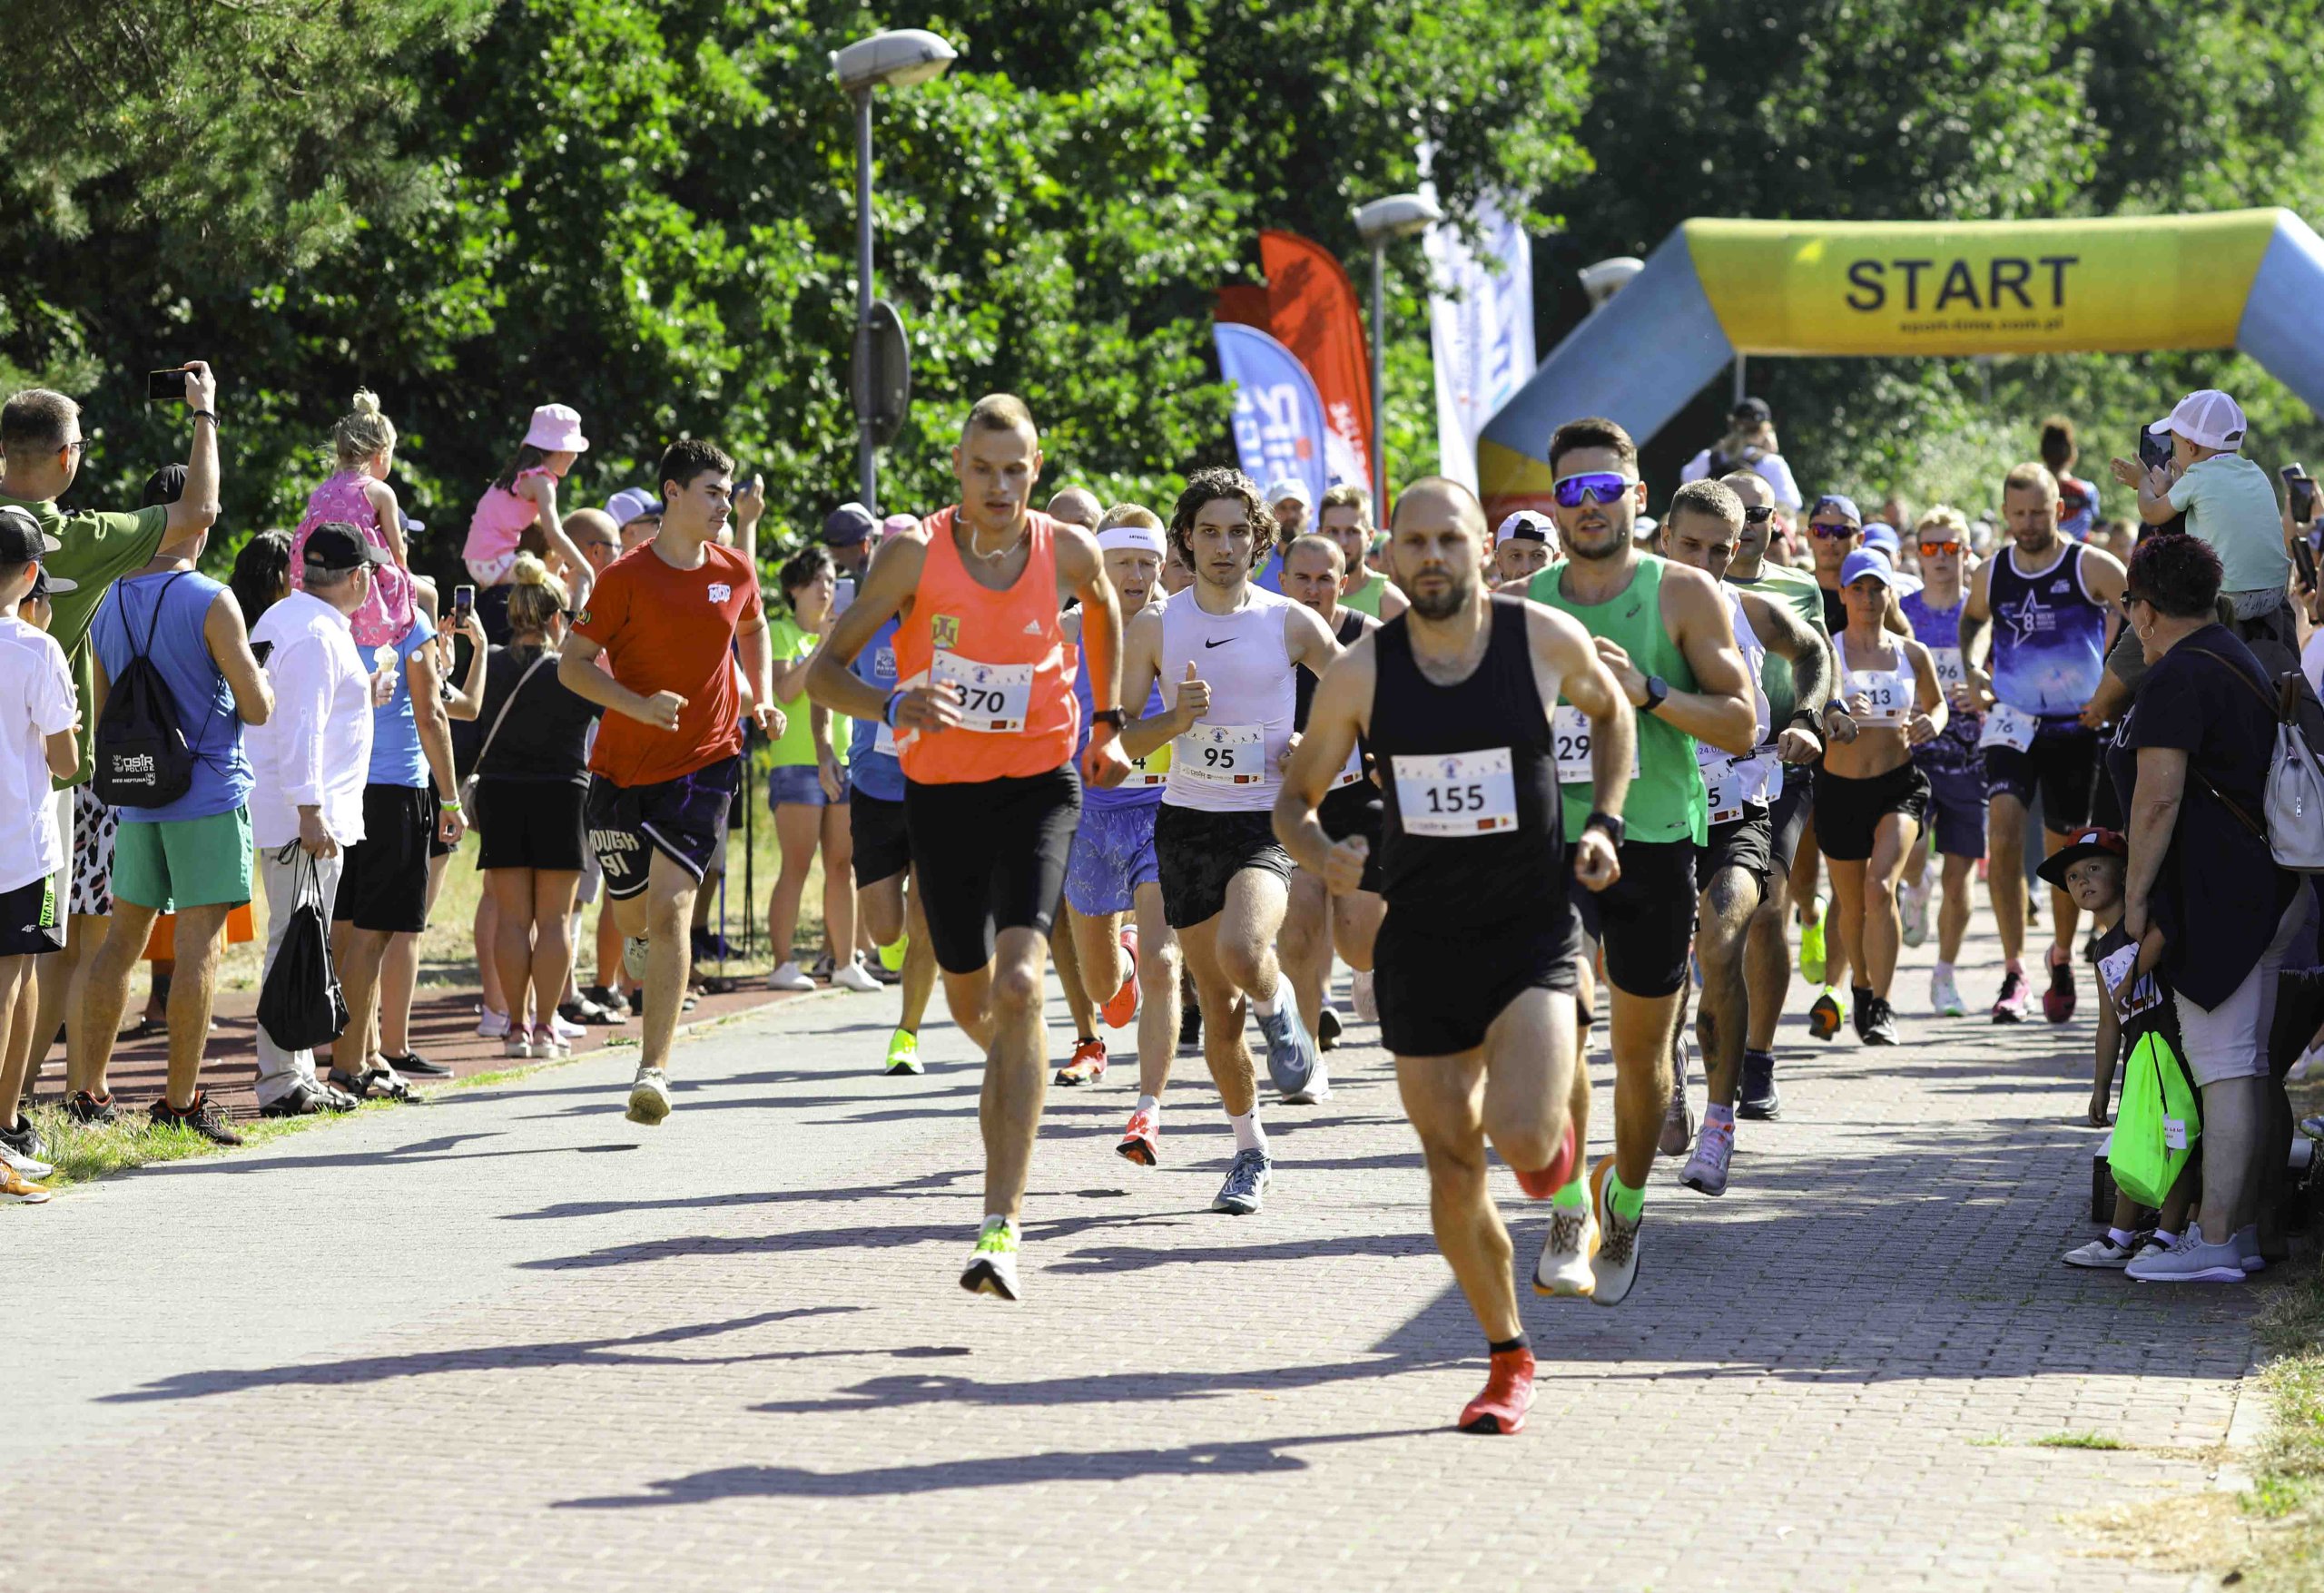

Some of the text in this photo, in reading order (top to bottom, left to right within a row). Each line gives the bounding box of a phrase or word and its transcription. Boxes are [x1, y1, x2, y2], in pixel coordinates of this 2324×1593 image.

[1846, 254, 2079, 311] START
[954, 684, 1005, 713] 370
[1863, 689, 1891, 705] 13
[1996, 719, 2014, 733] 76
[1204, 748, 1234, 769] 95
[1558, 734, 1591, 761] 29
[125, 765, 155, 773] POLICE
[1426, 784, 1484, 813] 155
[599, 851, 632, 878] 91
[21, 924, 36, 933] 4F
